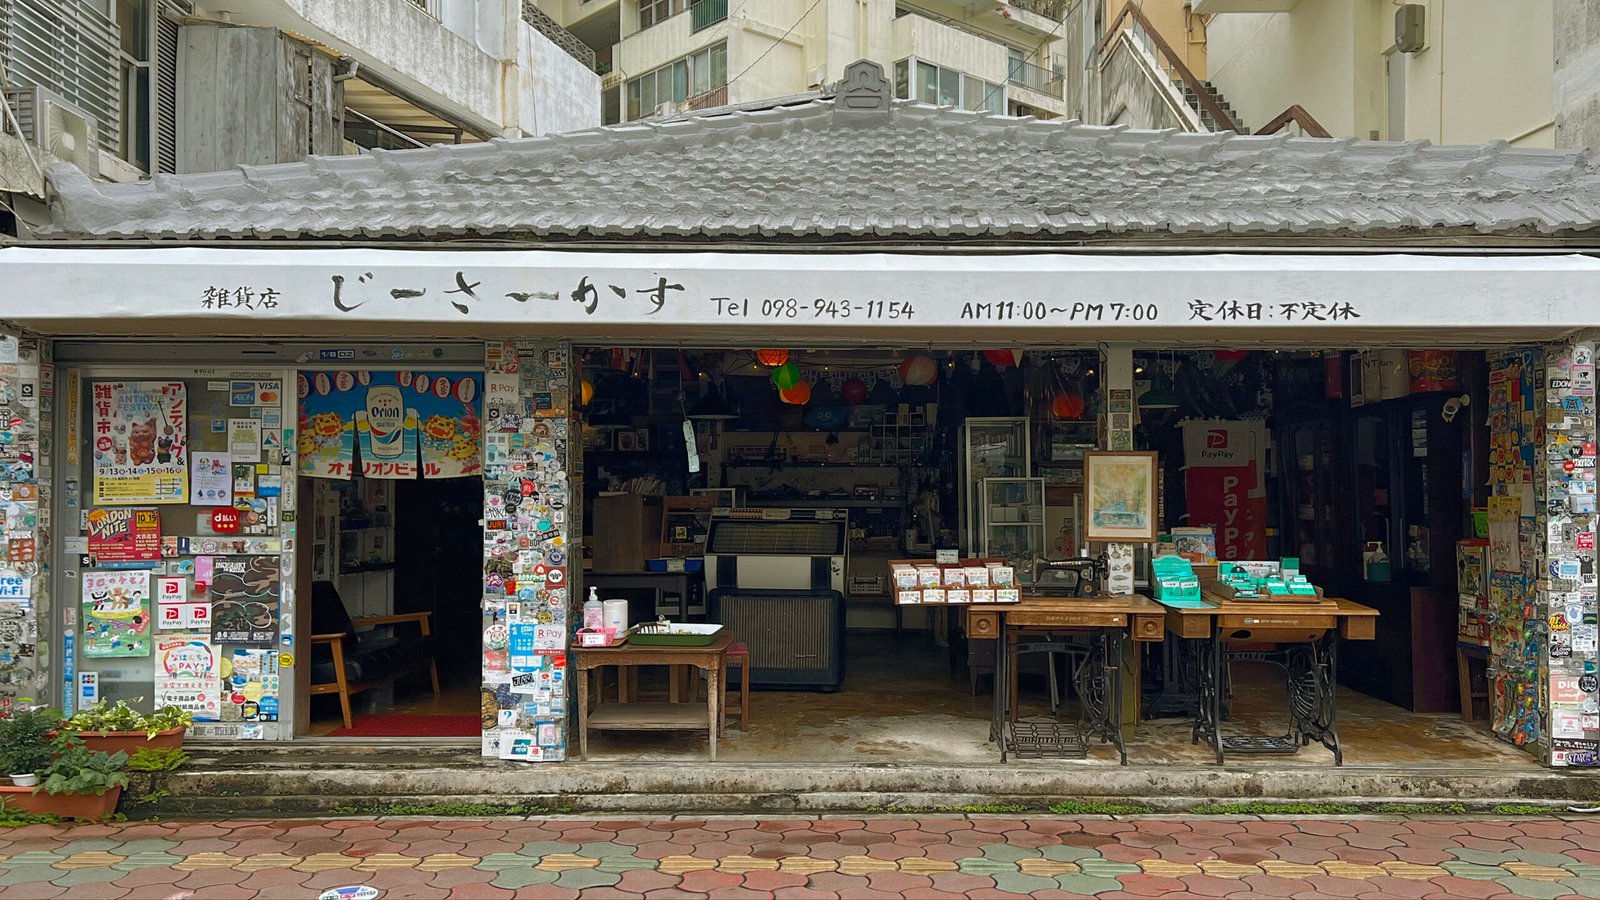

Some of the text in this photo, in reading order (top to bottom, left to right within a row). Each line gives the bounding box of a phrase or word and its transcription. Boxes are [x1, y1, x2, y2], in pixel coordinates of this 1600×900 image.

[201, 286, 281, 310] 雑貨店
[709, 297, 915, 320] Tel 098-943-1154
[258, 383, 280, 391] VISA
[499, 384, 516, 393] Pay
[371, 406, 399, 418] Orion
[1201, 451, 1233, 460] PayPay
[88, 509, 133, 536] LONDON
[1223, 476, 1239, 560] PayPa
[102, 521, 128, 541] NITE
[547, 630, 563, 639] Pay
